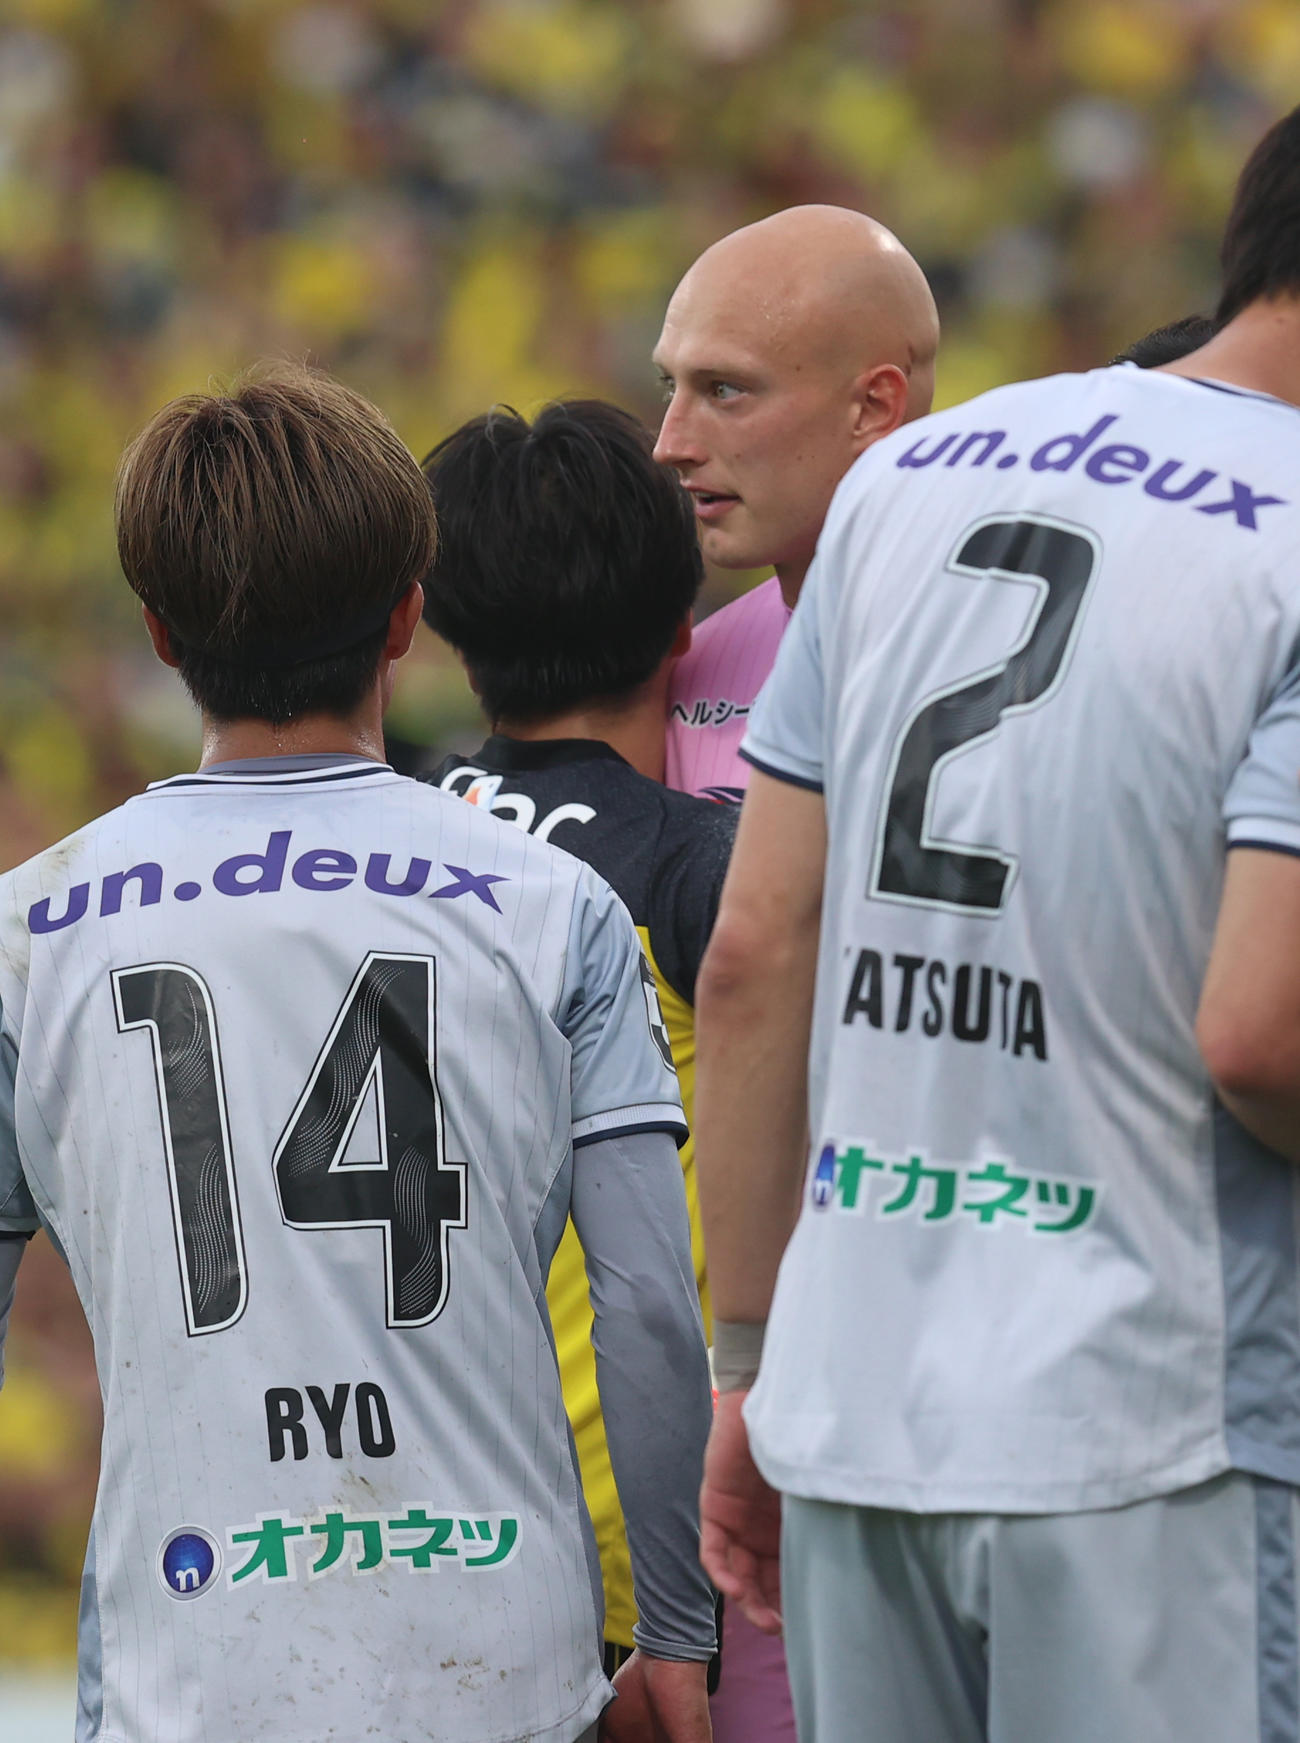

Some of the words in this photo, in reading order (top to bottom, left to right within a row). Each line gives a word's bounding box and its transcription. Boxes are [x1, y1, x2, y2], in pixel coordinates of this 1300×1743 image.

[896, 414, 1287, 531] un.deux
[866, 511, 1103, 919] 2
[28, 830, 511, 934] un.deux
[110, 951, 467, 1337] 14
[264, 1382, 396, 1462] RYO
